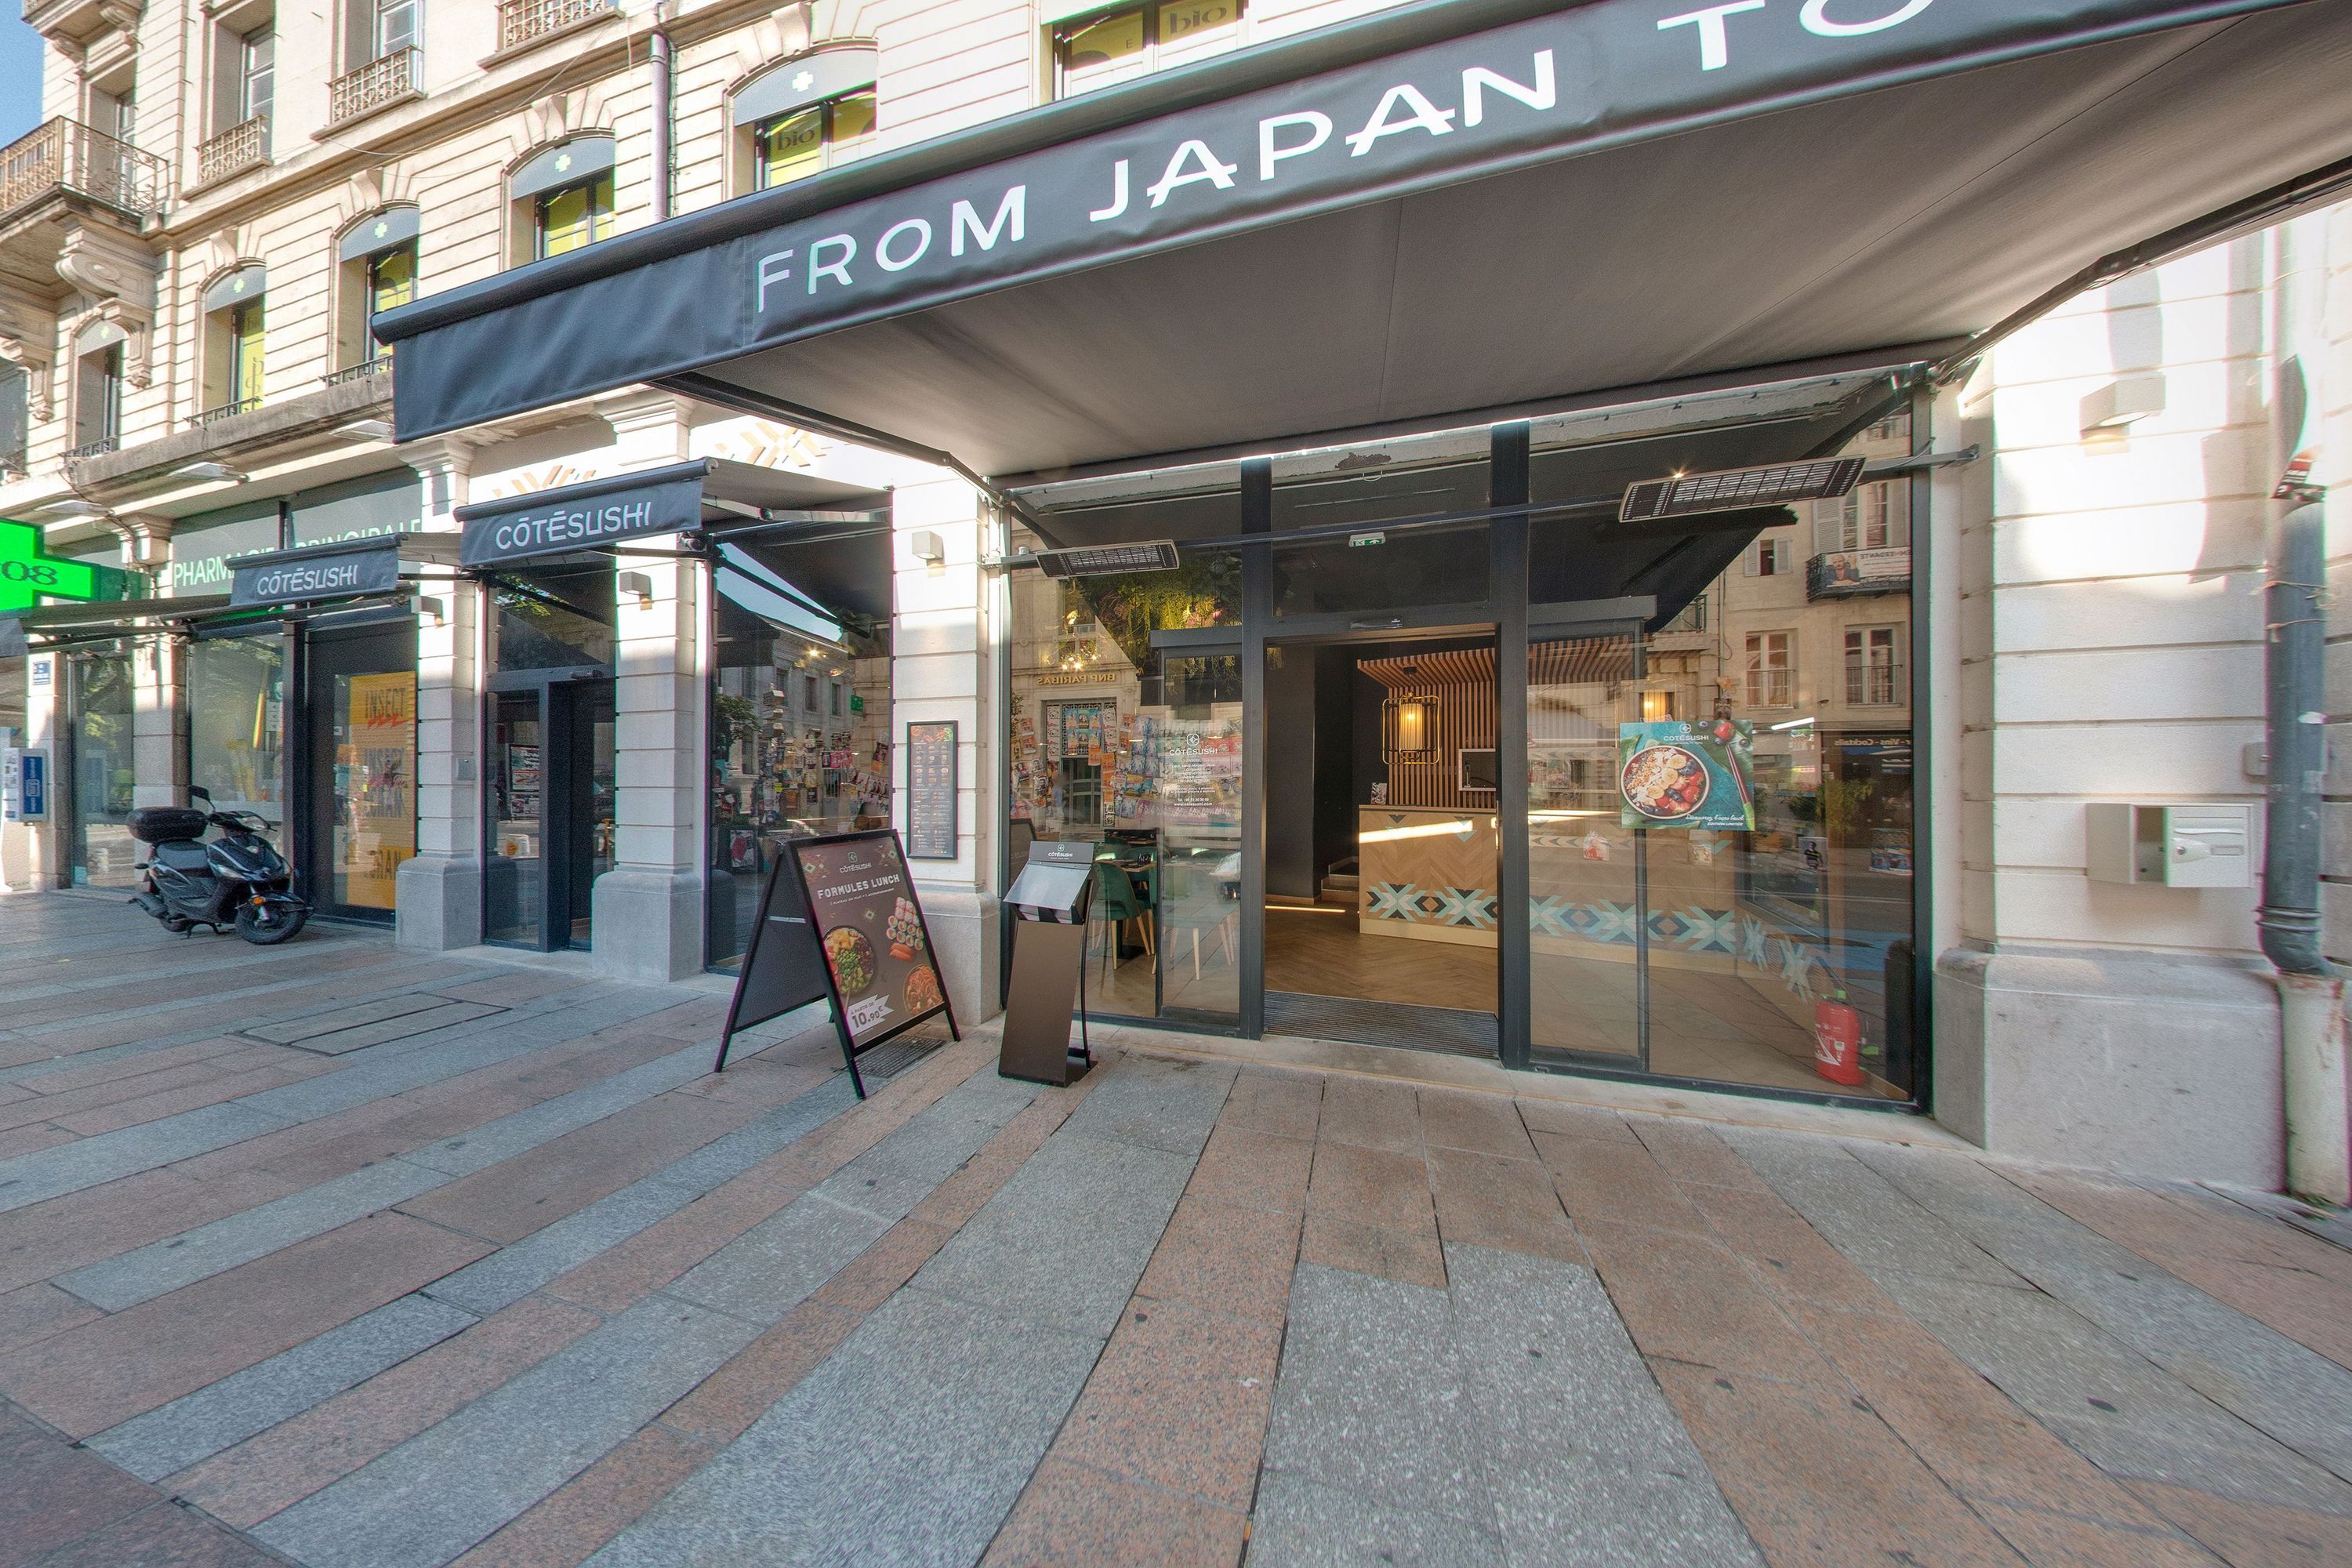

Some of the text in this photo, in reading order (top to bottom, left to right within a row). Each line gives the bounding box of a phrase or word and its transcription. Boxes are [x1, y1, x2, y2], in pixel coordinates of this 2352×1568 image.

[1170, 7, 1227, 35] bio
[776, 129, 815, 151] bio
[757, 184, 1026, 314] FROM
[1088, 49, 1559, 223] JAPAN
[365, 688, 405, 719] INSECT
[817, 873, 901, 899] FORMULES LUNCH
